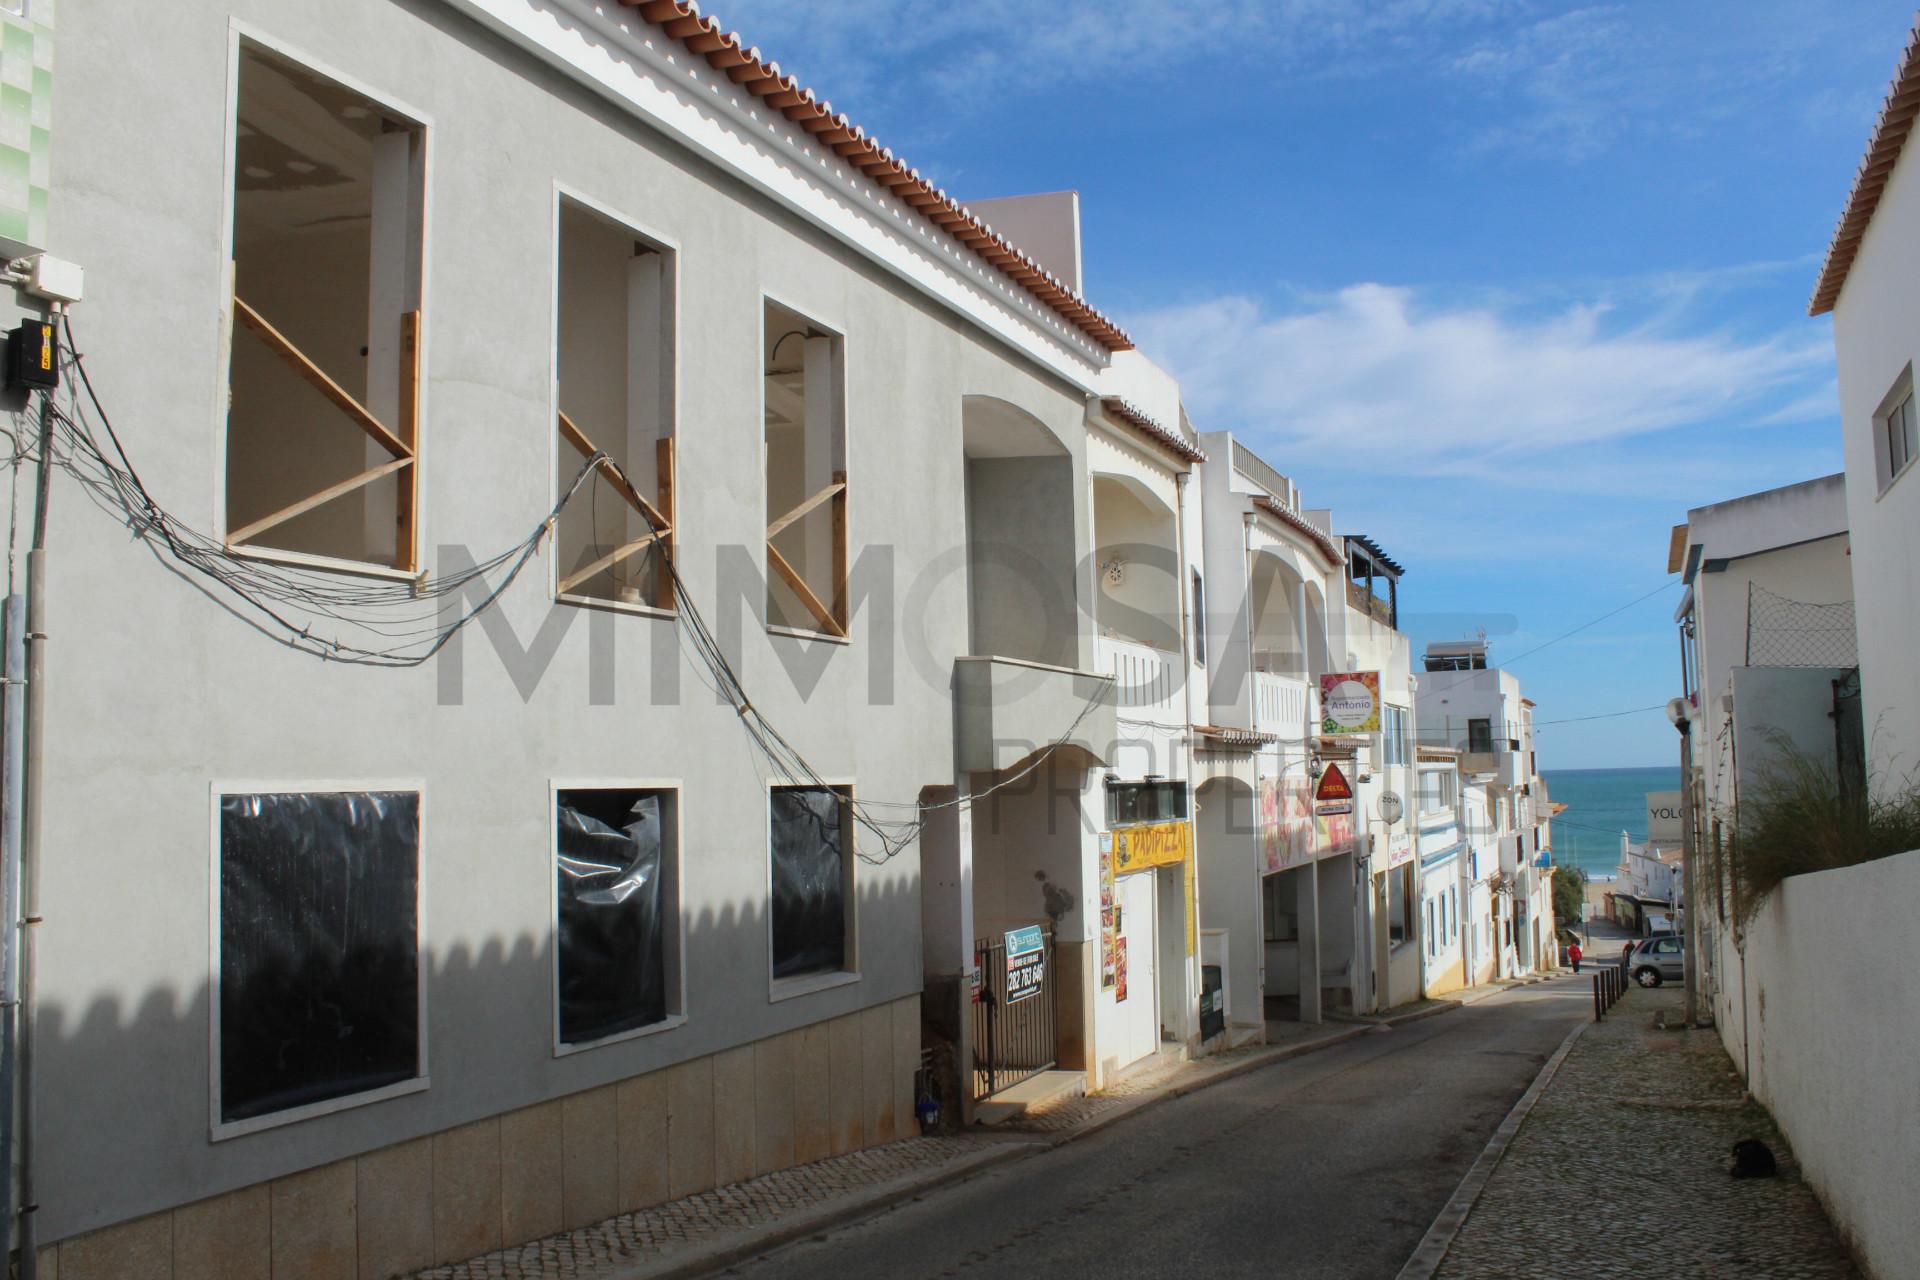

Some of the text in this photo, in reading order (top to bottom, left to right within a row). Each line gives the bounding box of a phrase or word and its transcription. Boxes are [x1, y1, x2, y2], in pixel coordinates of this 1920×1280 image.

[1331, 700, 1371, 710] Antonio
[1382, 796, 1399, 804] ZON
[1008, 969, 1021, 992] 282
[1021, 966, 1032, 988] 763
